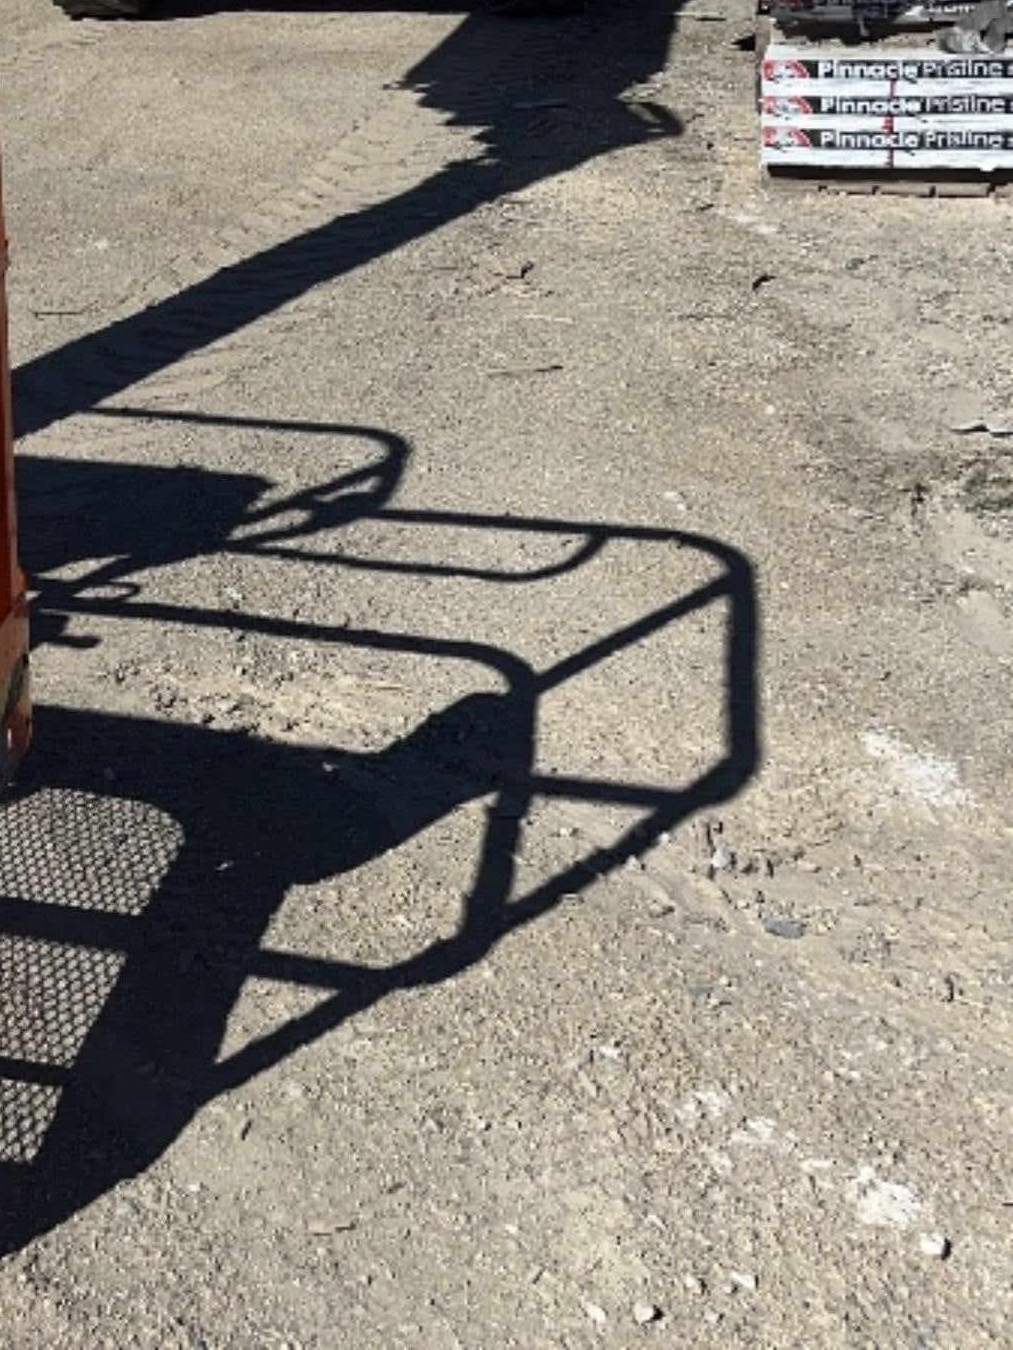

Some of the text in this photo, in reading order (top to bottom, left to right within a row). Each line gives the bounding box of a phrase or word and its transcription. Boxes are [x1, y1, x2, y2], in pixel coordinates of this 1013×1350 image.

[817, 59, 1003, 79] Pinnacle Pristine
[820, 95, 1005, 114] Pinnacle Pristine
[820, 130, 1004, 149] Pinnacle Pristine
